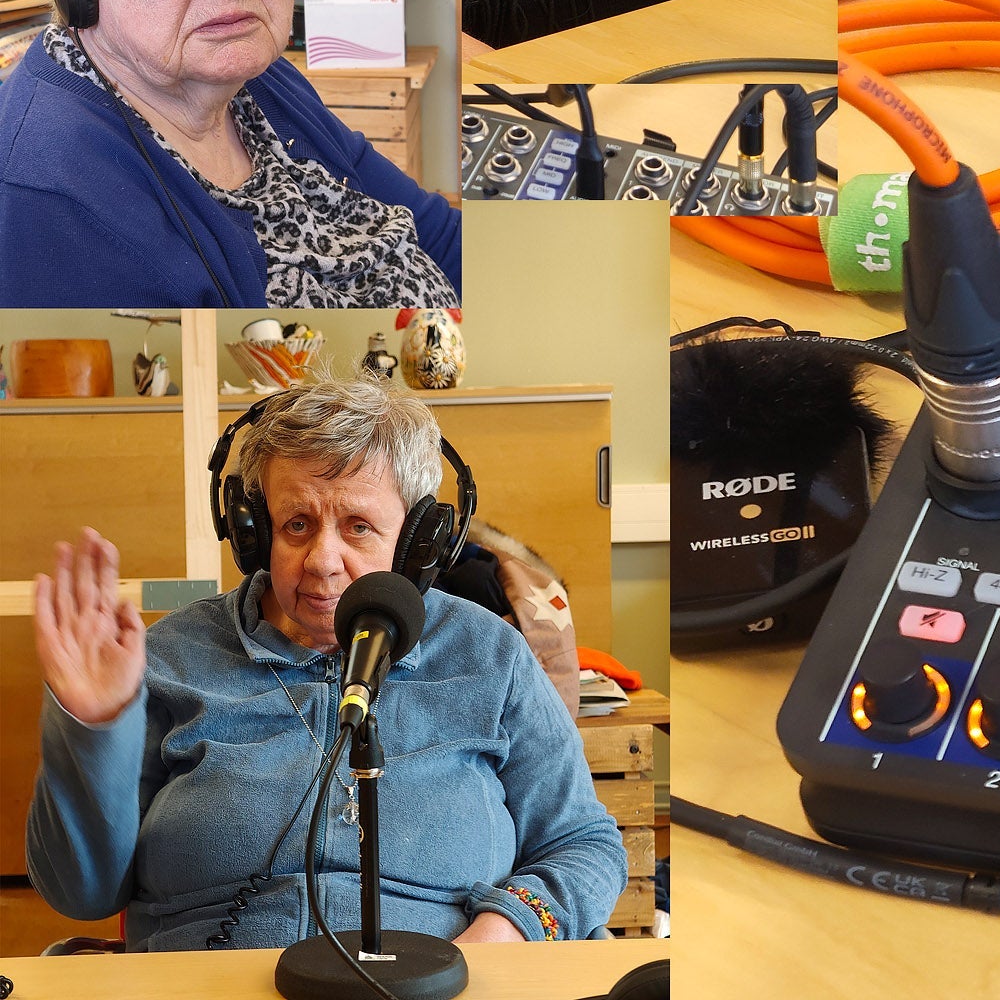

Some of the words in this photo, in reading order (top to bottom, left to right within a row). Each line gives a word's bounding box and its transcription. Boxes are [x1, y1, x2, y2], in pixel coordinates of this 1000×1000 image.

[858, 76, 952, 164] MICROPHONE
[702, 472, 797, 500] RØDE
[690, 532, 770, 551] WIRELESS
[936, 556, 980, 571] SIGNAL
[911, 566, 948, 582] Hi-Z
[870, 752, 884, 769] 1
